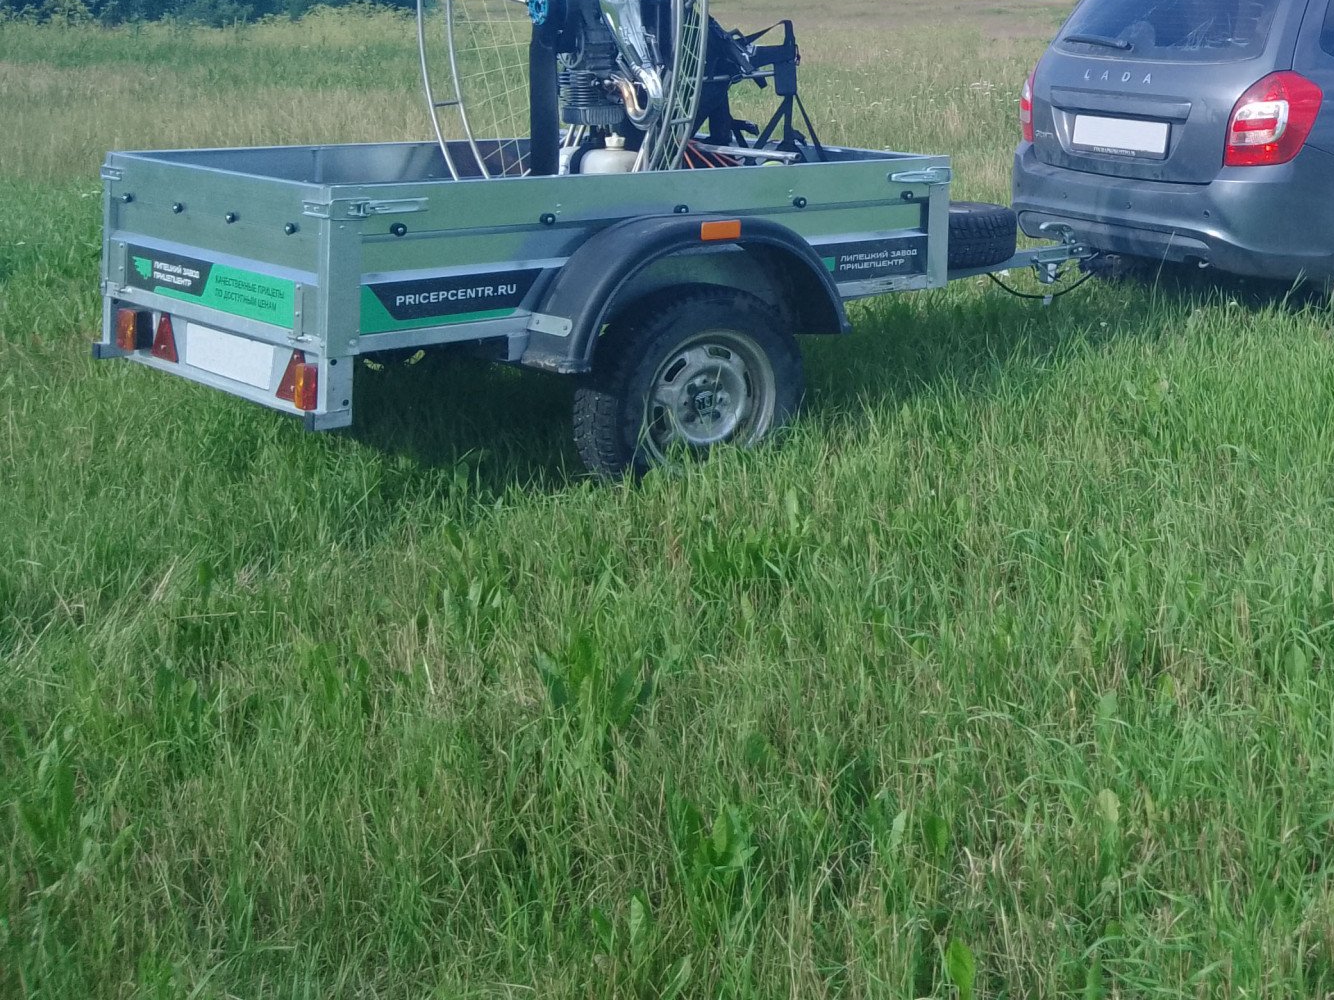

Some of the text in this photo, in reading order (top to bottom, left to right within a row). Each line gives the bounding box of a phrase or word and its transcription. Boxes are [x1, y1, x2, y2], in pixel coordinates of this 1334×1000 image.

[1084, 69, 1152, 84] LADA
[841, 249, 917, 261] ЛИПЕЦКИЙ ЗАВОД
[840, 259, 904, 270] ПРИЦЕПЦЕНТР
[396, 284, 517, 306] PRICEPCENTR.RU
